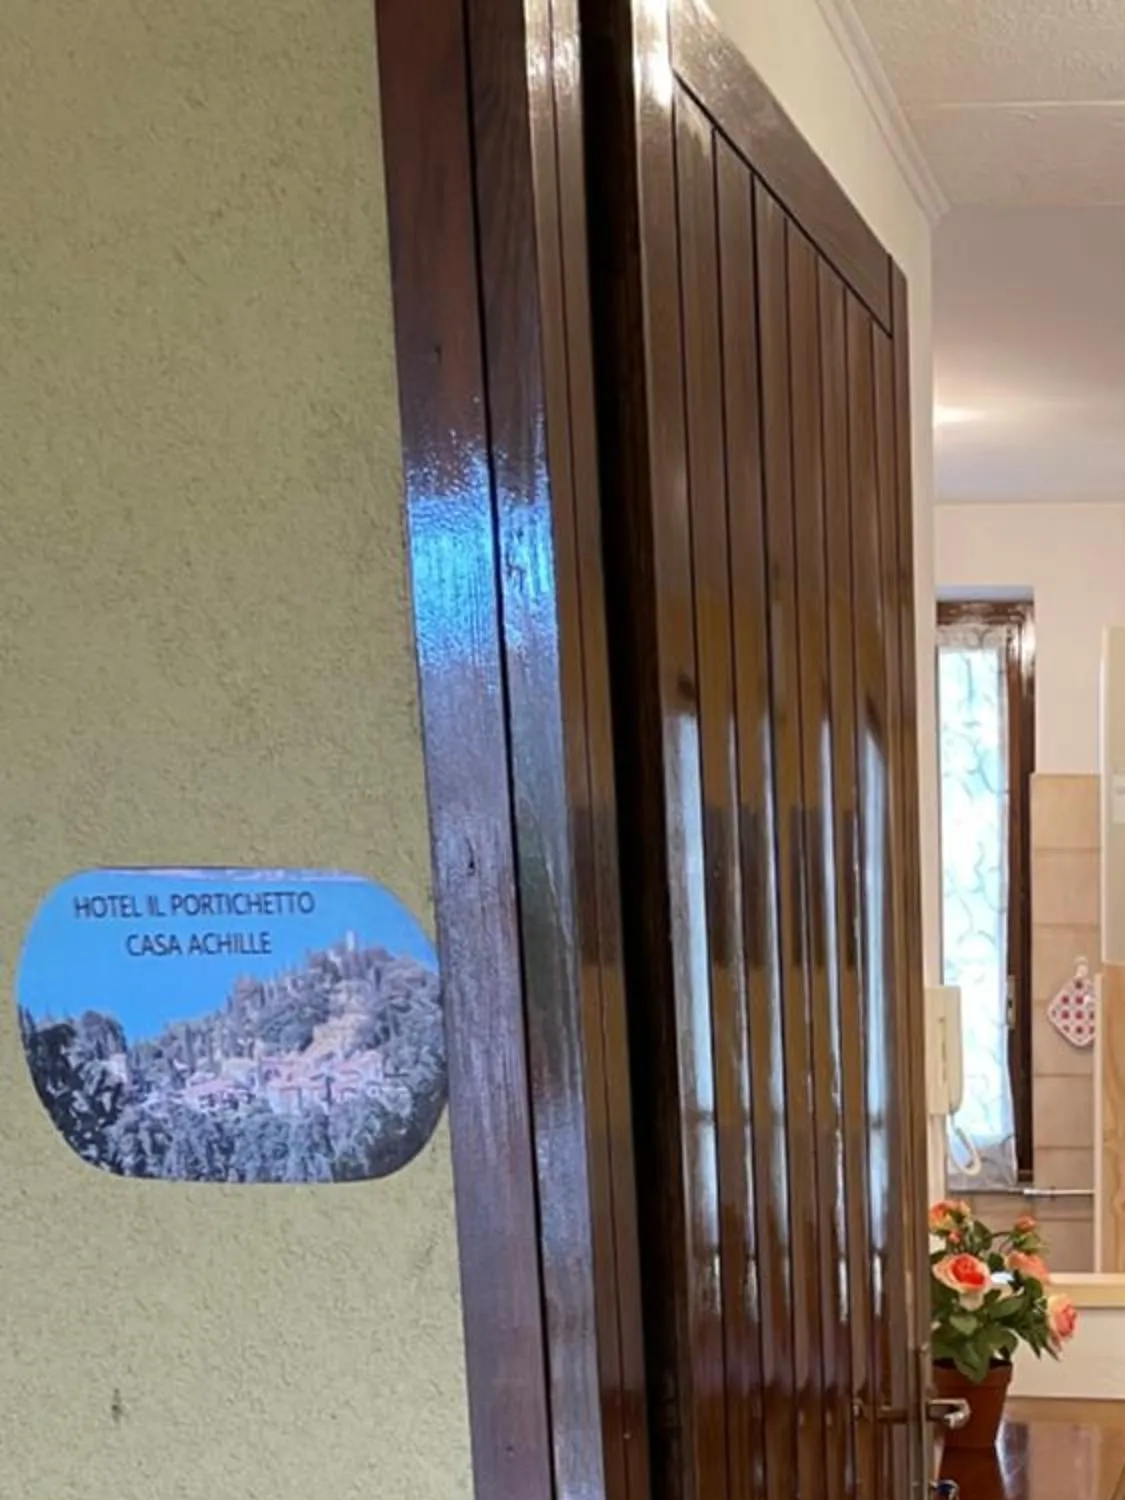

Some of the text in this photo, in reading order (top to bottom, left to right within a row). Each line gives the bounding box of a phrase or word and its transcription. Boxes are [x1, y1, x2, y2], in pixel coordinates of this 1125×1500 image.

[74, 891, 316, 919] HOTEL IL PORTICHETTO
[126, 931, 273, 957] CASA ACHILLE
